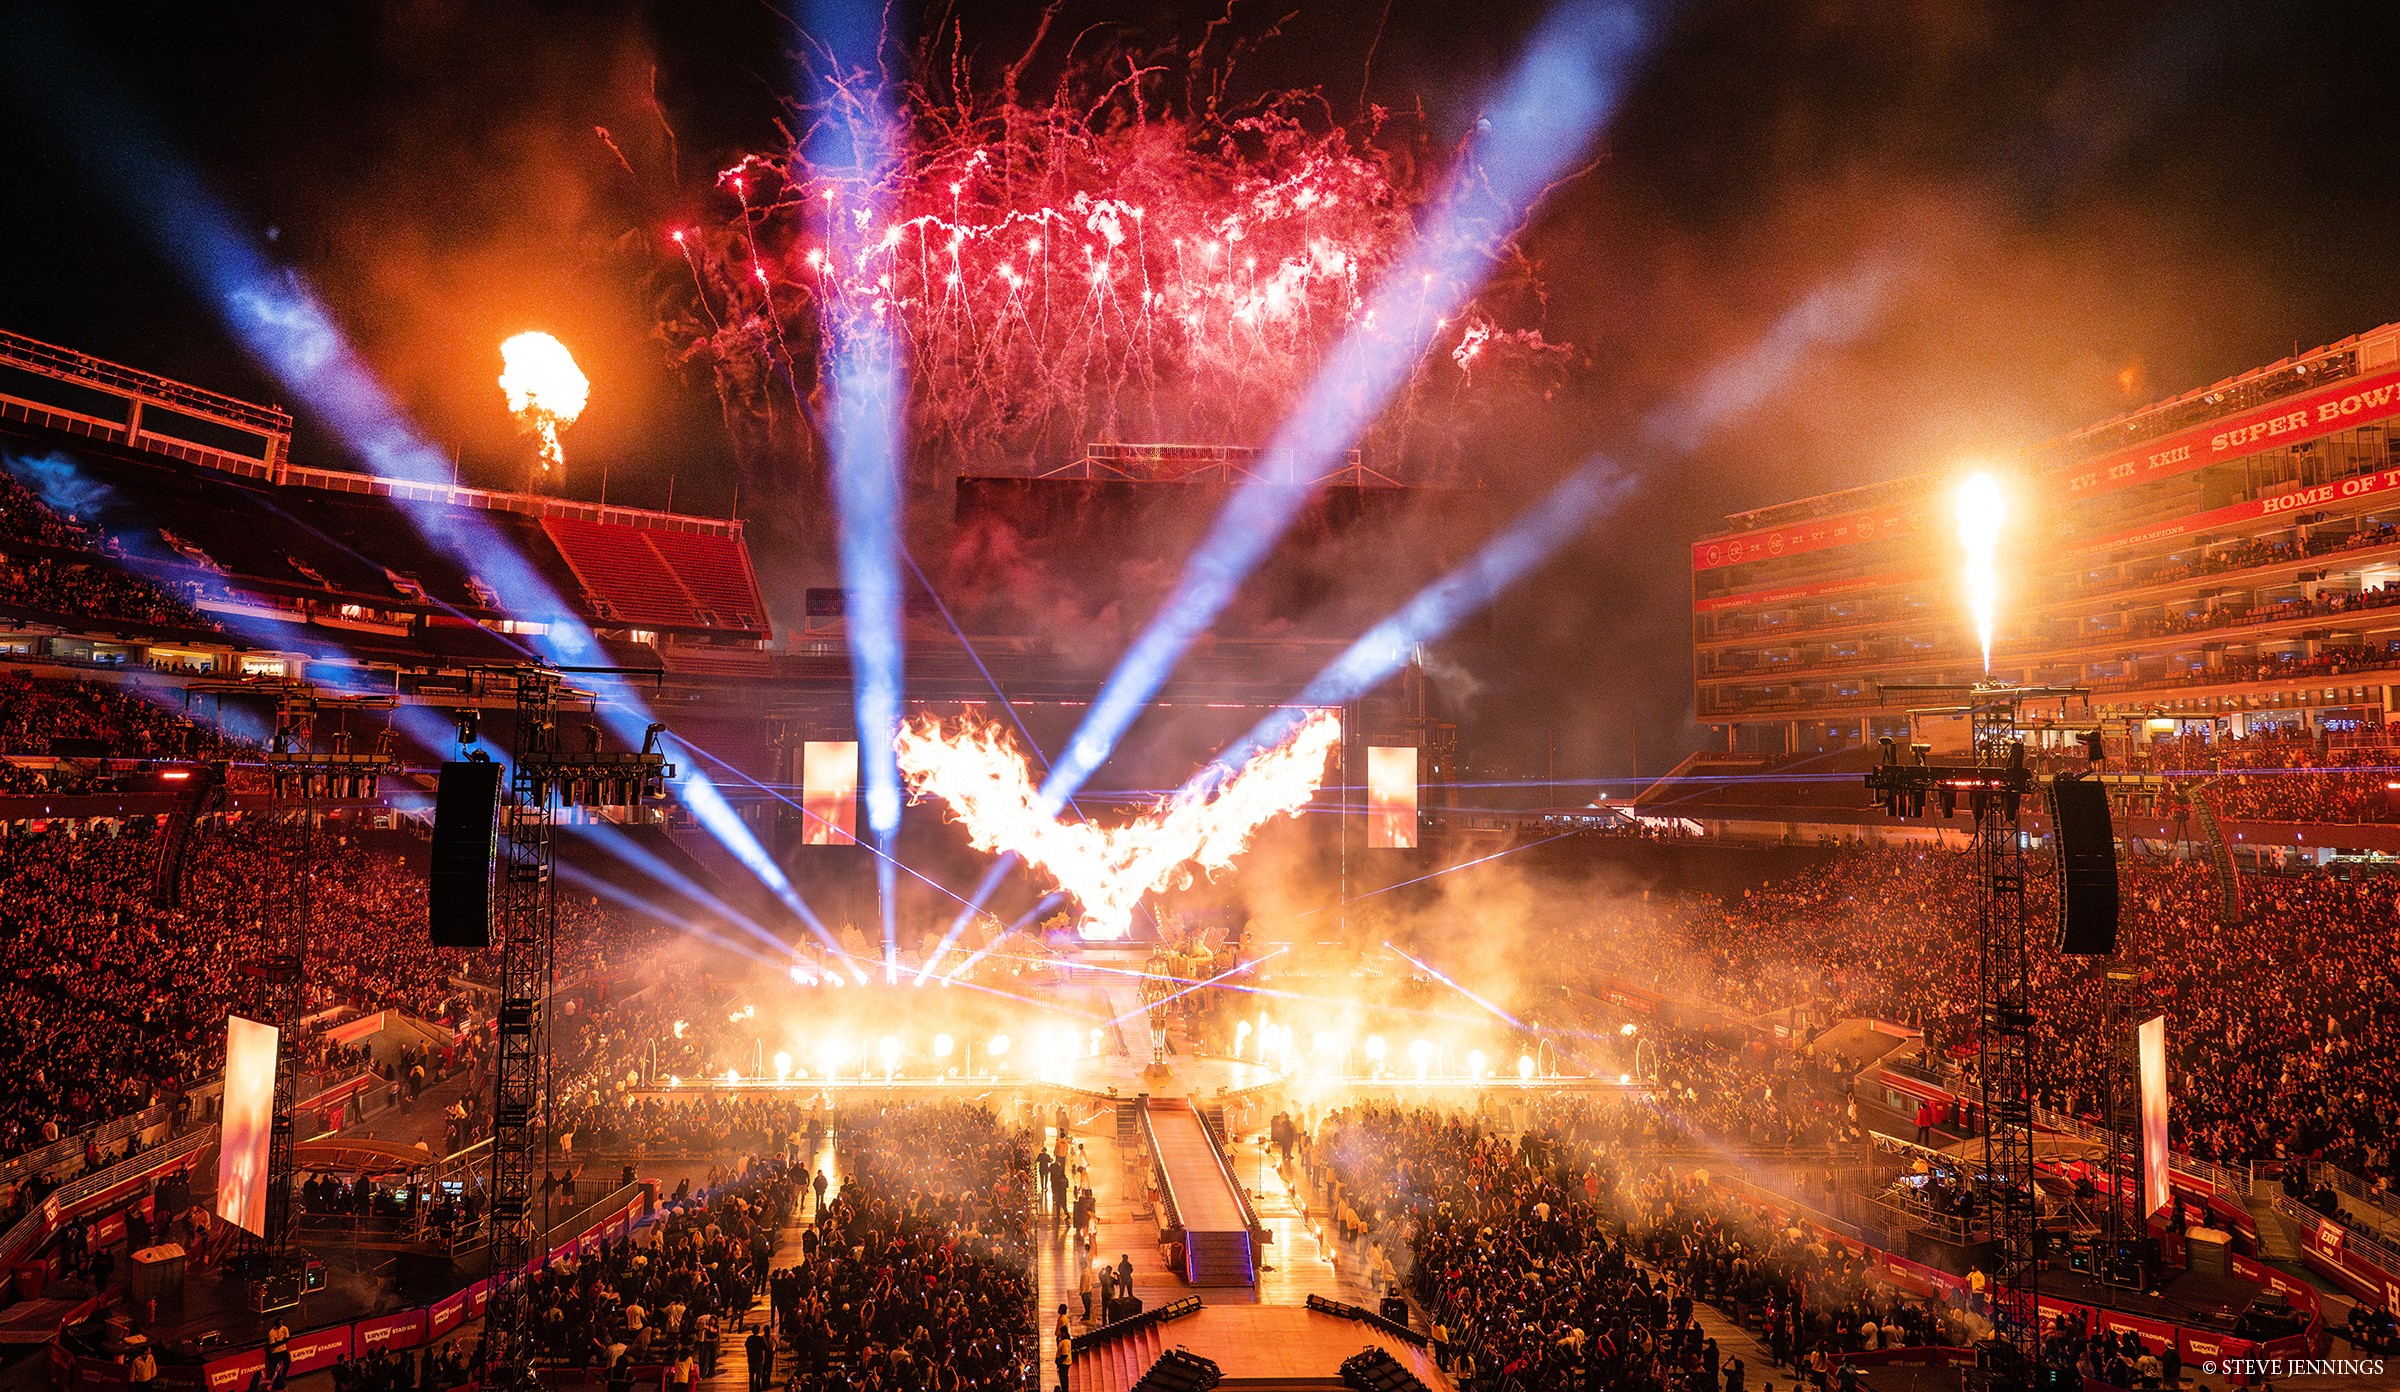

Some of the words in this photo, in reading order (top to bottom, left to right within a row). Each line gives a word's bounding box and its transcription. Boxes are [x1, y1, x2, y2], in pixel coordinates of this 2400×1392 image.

[2108, 461, 2136, 480] XIX
[2148, 445, 2191, 469] XXIII
[2211, 410, 2309, 453] SUPER
[2317, 382, 2400, 422] BOW
[2262, 485, 2334, 514] HOME
[2342, 476, 2376, 496] OF
[1792, 535, 1803, 544] 21
[2129, 526, 2184, 544] CHAMPIONS
[2321, 1230, 2340, 1247] EXIT
